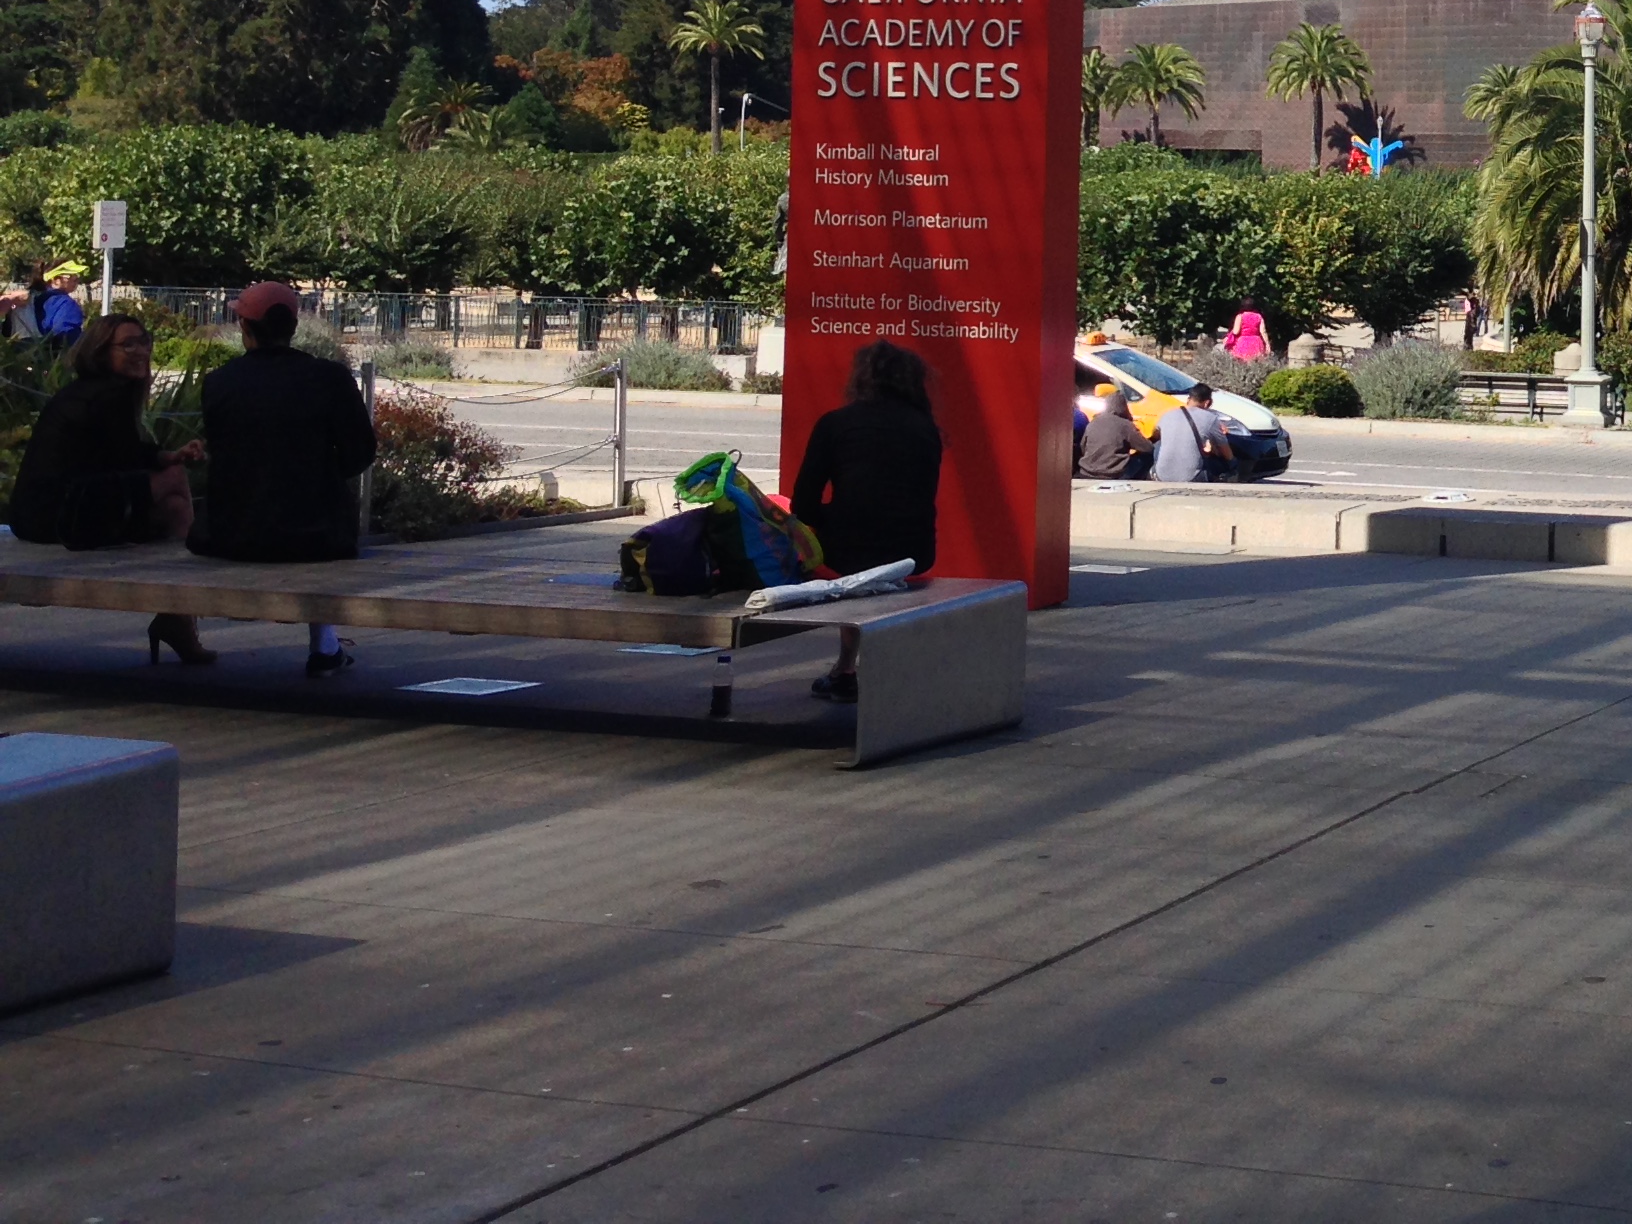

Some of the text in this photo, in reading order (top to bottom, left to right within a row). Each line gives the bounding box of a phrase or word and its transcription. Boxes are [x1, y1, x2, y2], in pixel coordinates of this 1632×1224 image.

[817, 18, 1023, 47] ACADEMY OF
[816, 61, 1021, 99] SCIENCES
[815, 142, 940, 161] Kimball Natural
[814, 167, 950, 188] History Museum
[813, 208, 989, 229] Morrison Planetarium
[812, 249, 970, 273] Steinhart Aquarium
[810, 291, 1001, 317] Institute for Biodiversity
[810, 316, 1020, 344] Science and Sustainability
